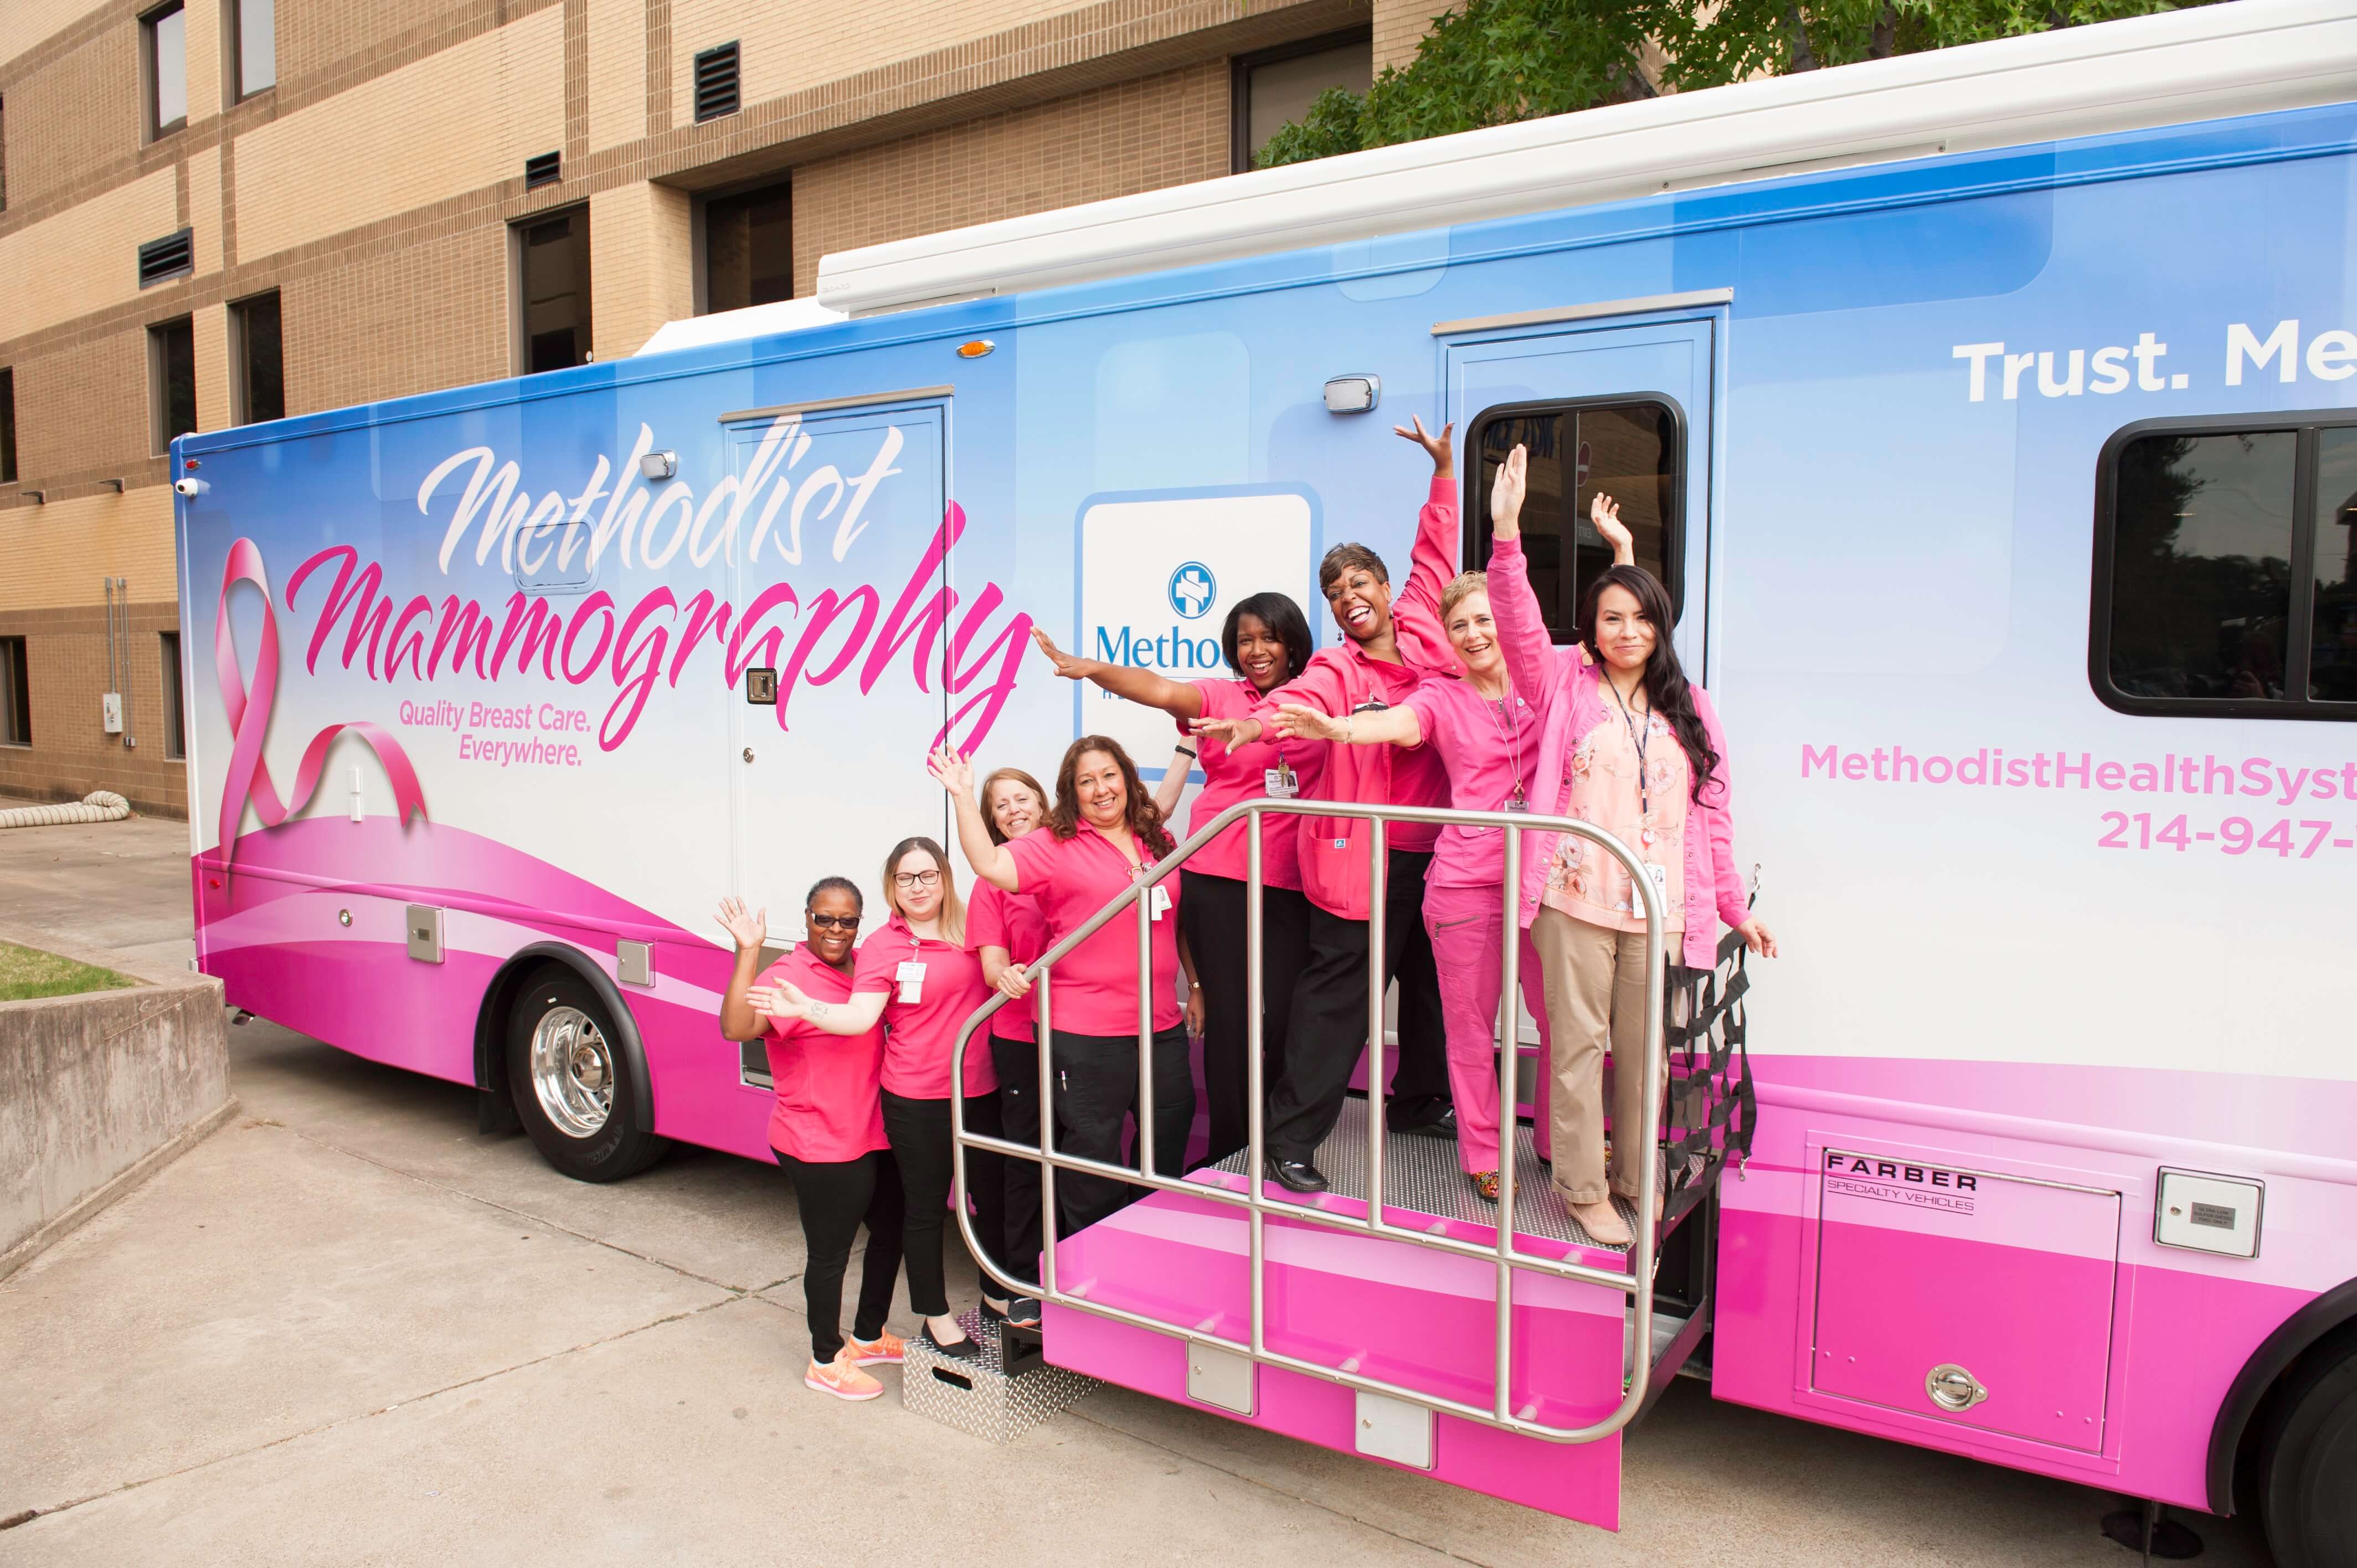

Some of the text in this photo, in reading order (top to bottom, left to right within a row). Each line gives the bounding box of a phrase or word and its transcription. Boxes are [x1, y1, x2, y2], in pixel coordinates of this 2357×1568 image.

[1953, 319, 2357, 402] Trust. Me
[417, 413, 904, 575] Methodist
[285, 499, 1034, 777] Mammography
[399, 700, 591, 731] Quality Breast Care.
[459, 734, 582, 767] Everywhere.
[1801, 744, 2357, 806] MethodistHealthSyst
[2098, 811, 2357, 858] 214-947-
[1827, 1179, 1974, 1211] SPECIALTY VEHICLES
[1828, 1155, 1977, 1191] FARBER
